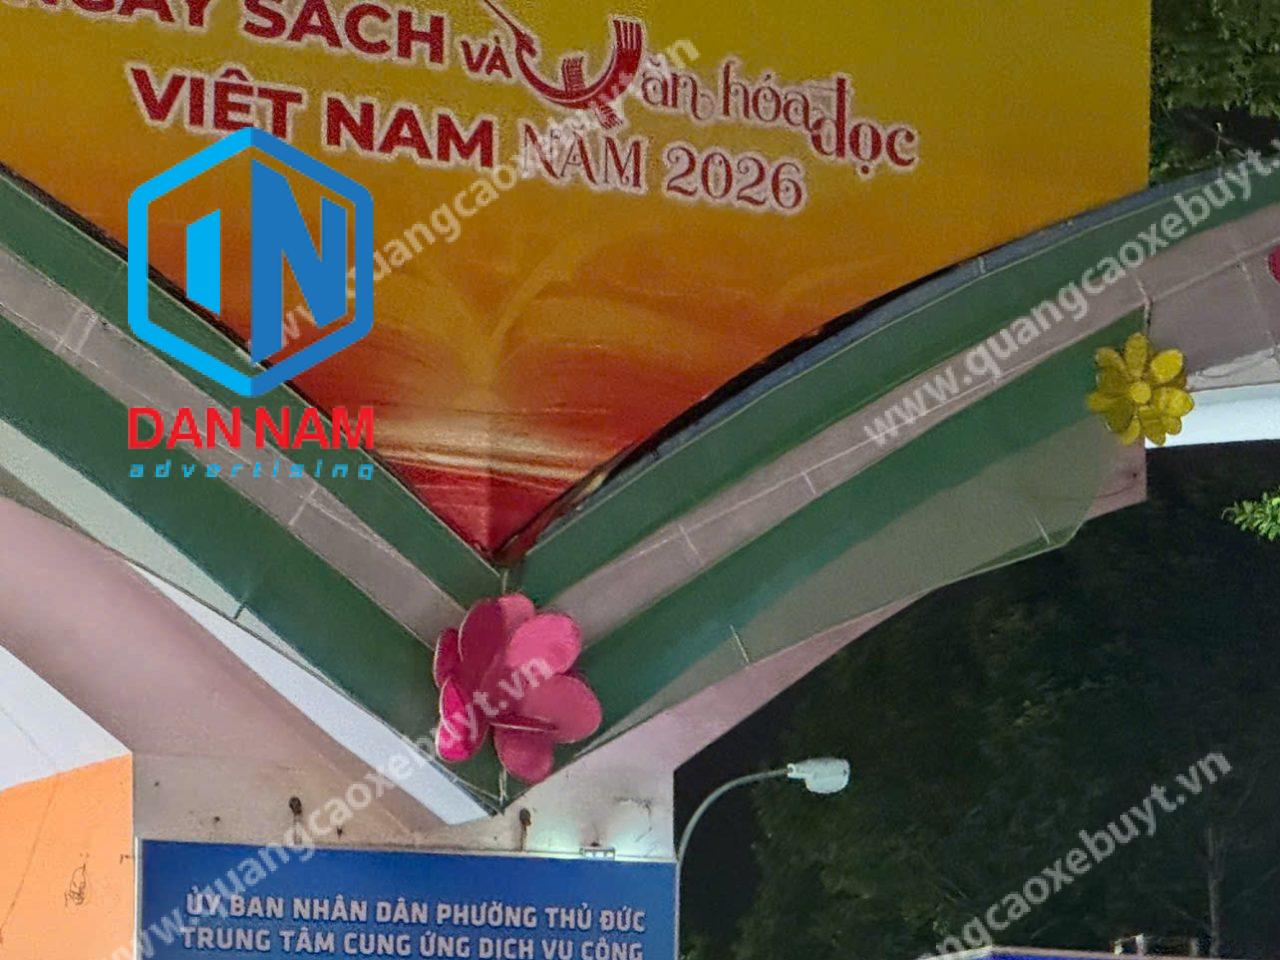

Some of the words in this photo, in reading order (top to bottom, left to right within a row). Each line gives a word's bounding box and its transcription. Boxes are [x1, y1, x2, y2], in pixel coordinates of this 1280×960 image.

[460, 35, 513, 79] VÀ
[722, 58, 812, 132] hóa
[326, 97, 494, 169] NAM
[665, 145, 805, 209] 2026
[181, 926, 271, 952] TRUNG
[279, 926, 335, 953] TÂM
[343, 932, 412, 957] CUNG
[419, 930, 471, 958] ỨNG
[230, 893, 285, 920] BAN
[292, 893, 369, 923] NHÂN
[375, 896, 428, 925] DÂN
[436, 900, 538, 929] PHƯỜNG
[544, 902, 592, 931] THỦ
[599, 905, 647, 933] ĐỨC
